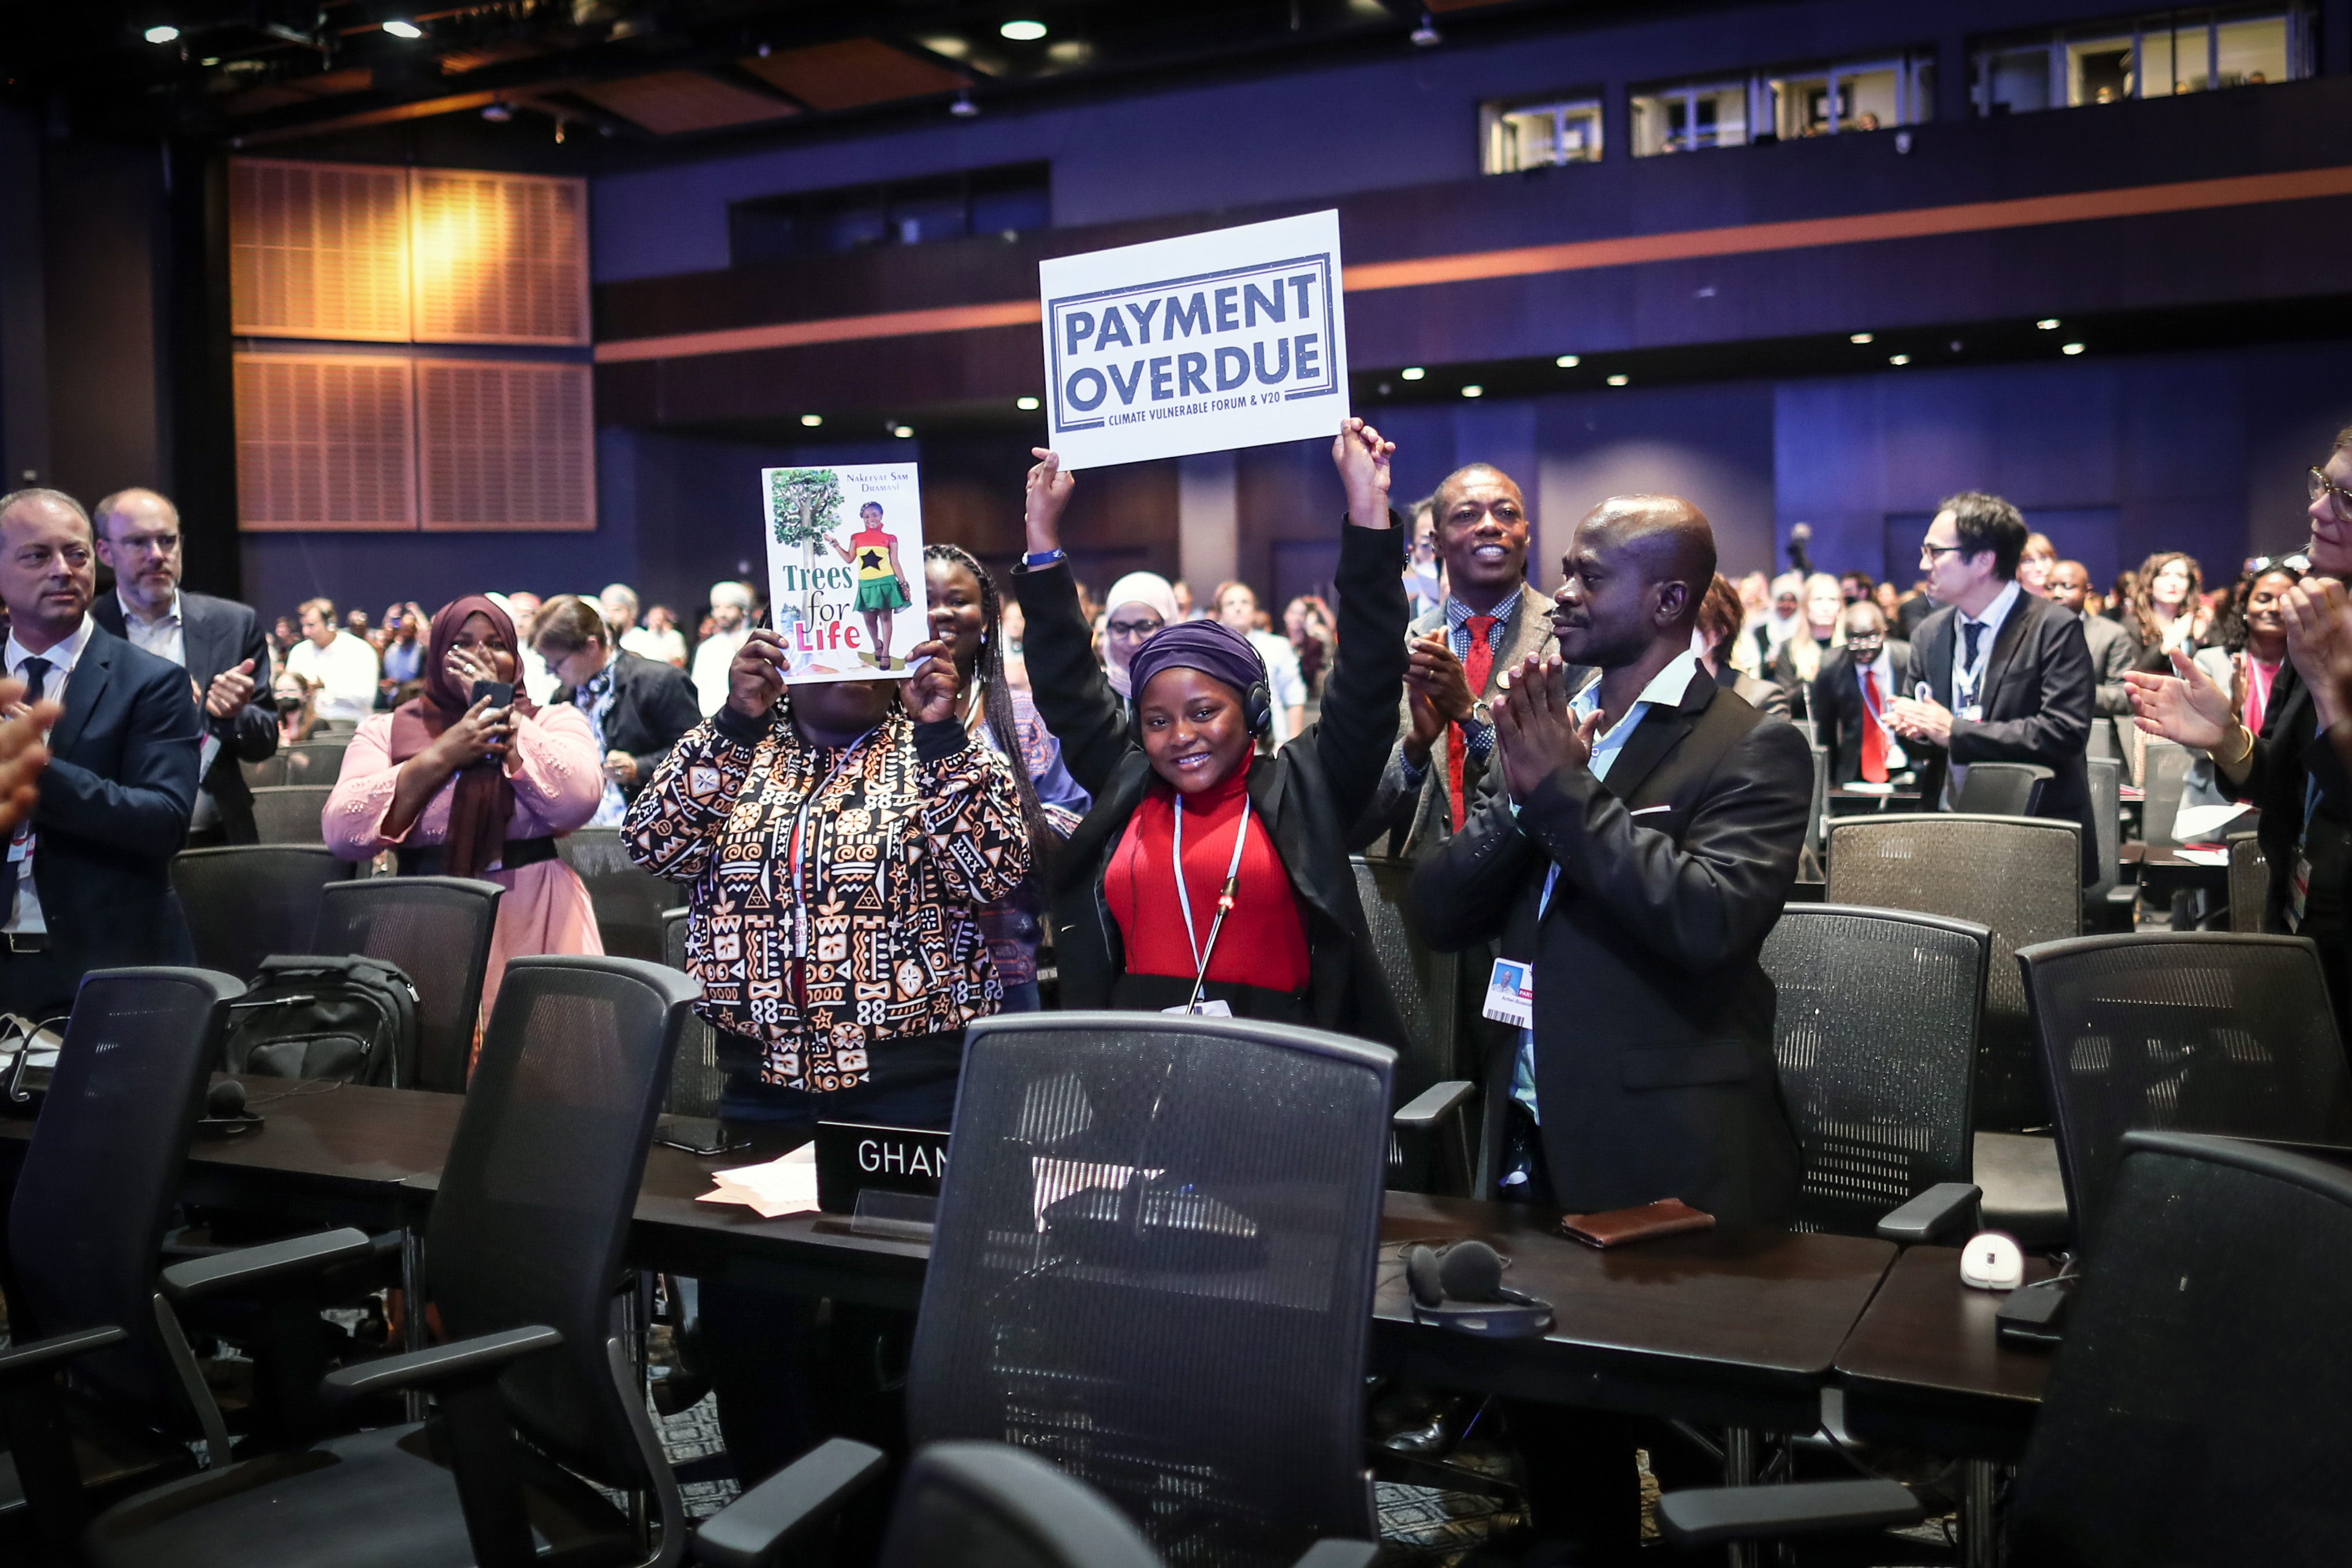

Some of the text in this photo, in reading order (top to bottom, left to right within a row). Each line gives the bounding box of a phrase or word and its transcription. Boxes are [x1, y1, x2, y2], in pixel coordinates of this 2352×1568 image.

[1065, 273, 1316, 355] PAYMENT
[1065, 333, 1320, 412] OVERDUE
[1109, 392, 1280, 426] CLIMATE VULNERABLE FORUM & V20
[783, 565, 853, 591] Trees
[802, 590, 850, 633] for
[796, 620, 861, 651] Life
[859, 1139, 948, 1177] GHAN
